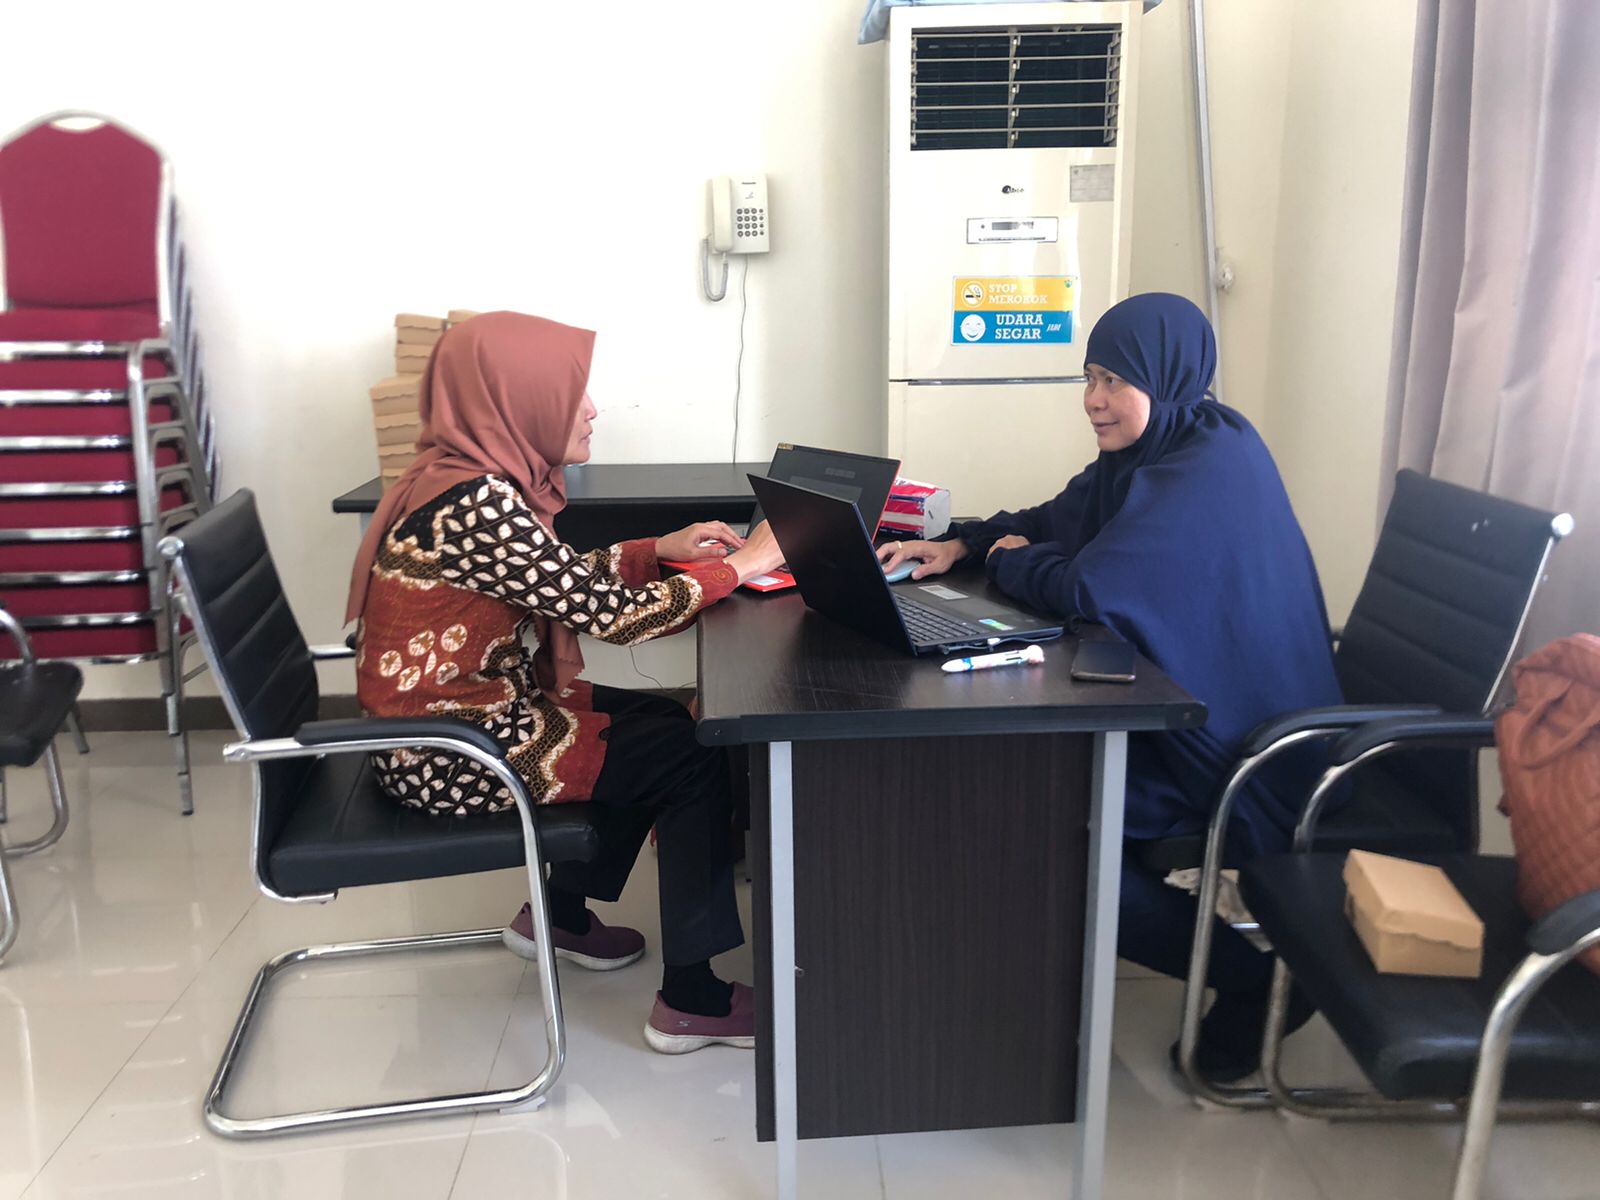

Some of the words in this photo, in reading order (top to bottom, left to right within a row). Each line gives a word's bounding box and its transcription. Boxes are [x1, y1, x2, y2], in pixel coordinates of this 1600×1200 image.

[988, 284, 1018, 293] STOP
[988, 294, 1048, 304] MEROKOK
[996, 314, 1044, 326] UDARA
[995, 328, 1042, 340] SEGAR
